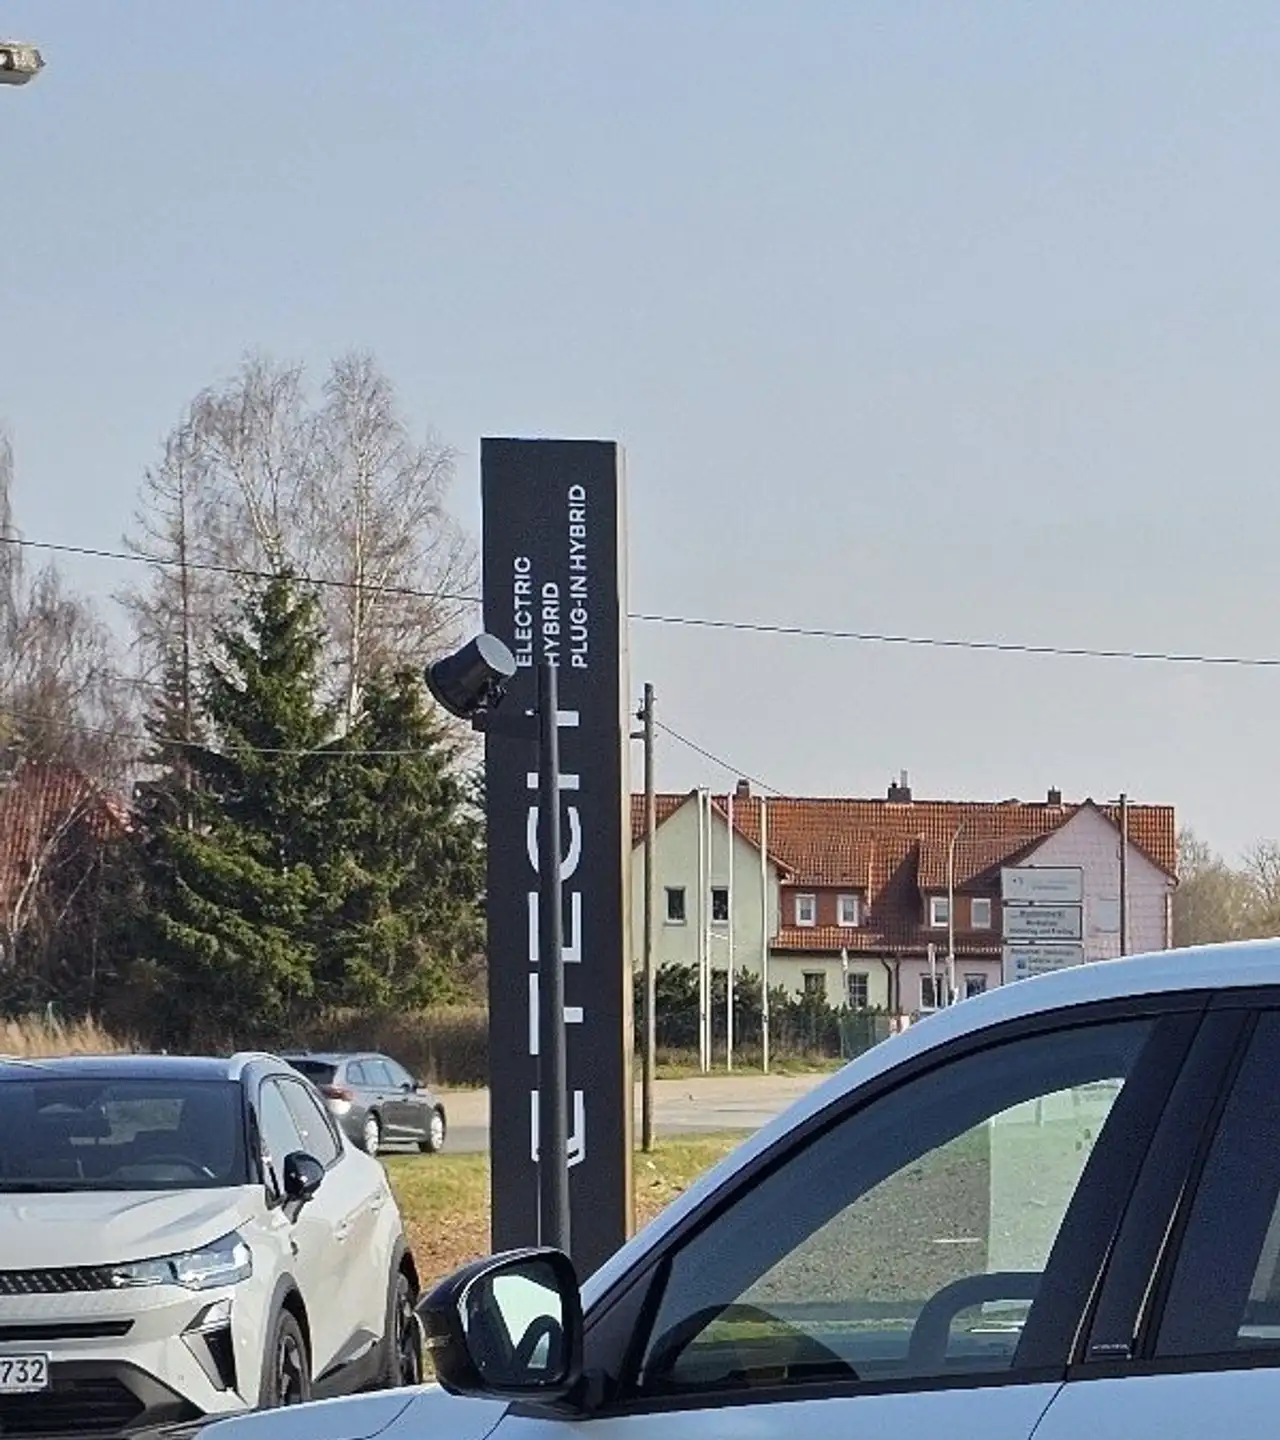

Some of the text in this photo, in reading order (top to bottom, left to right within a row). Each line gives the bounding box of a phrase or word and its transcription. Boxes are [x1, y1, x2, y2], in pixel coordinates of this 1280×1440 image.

[514, 556, 533, 668] ELECTRIC
[541, 582, 561, 668] HYBRID
[567, 484, 589, 669] PLUG-IN HYBRID
